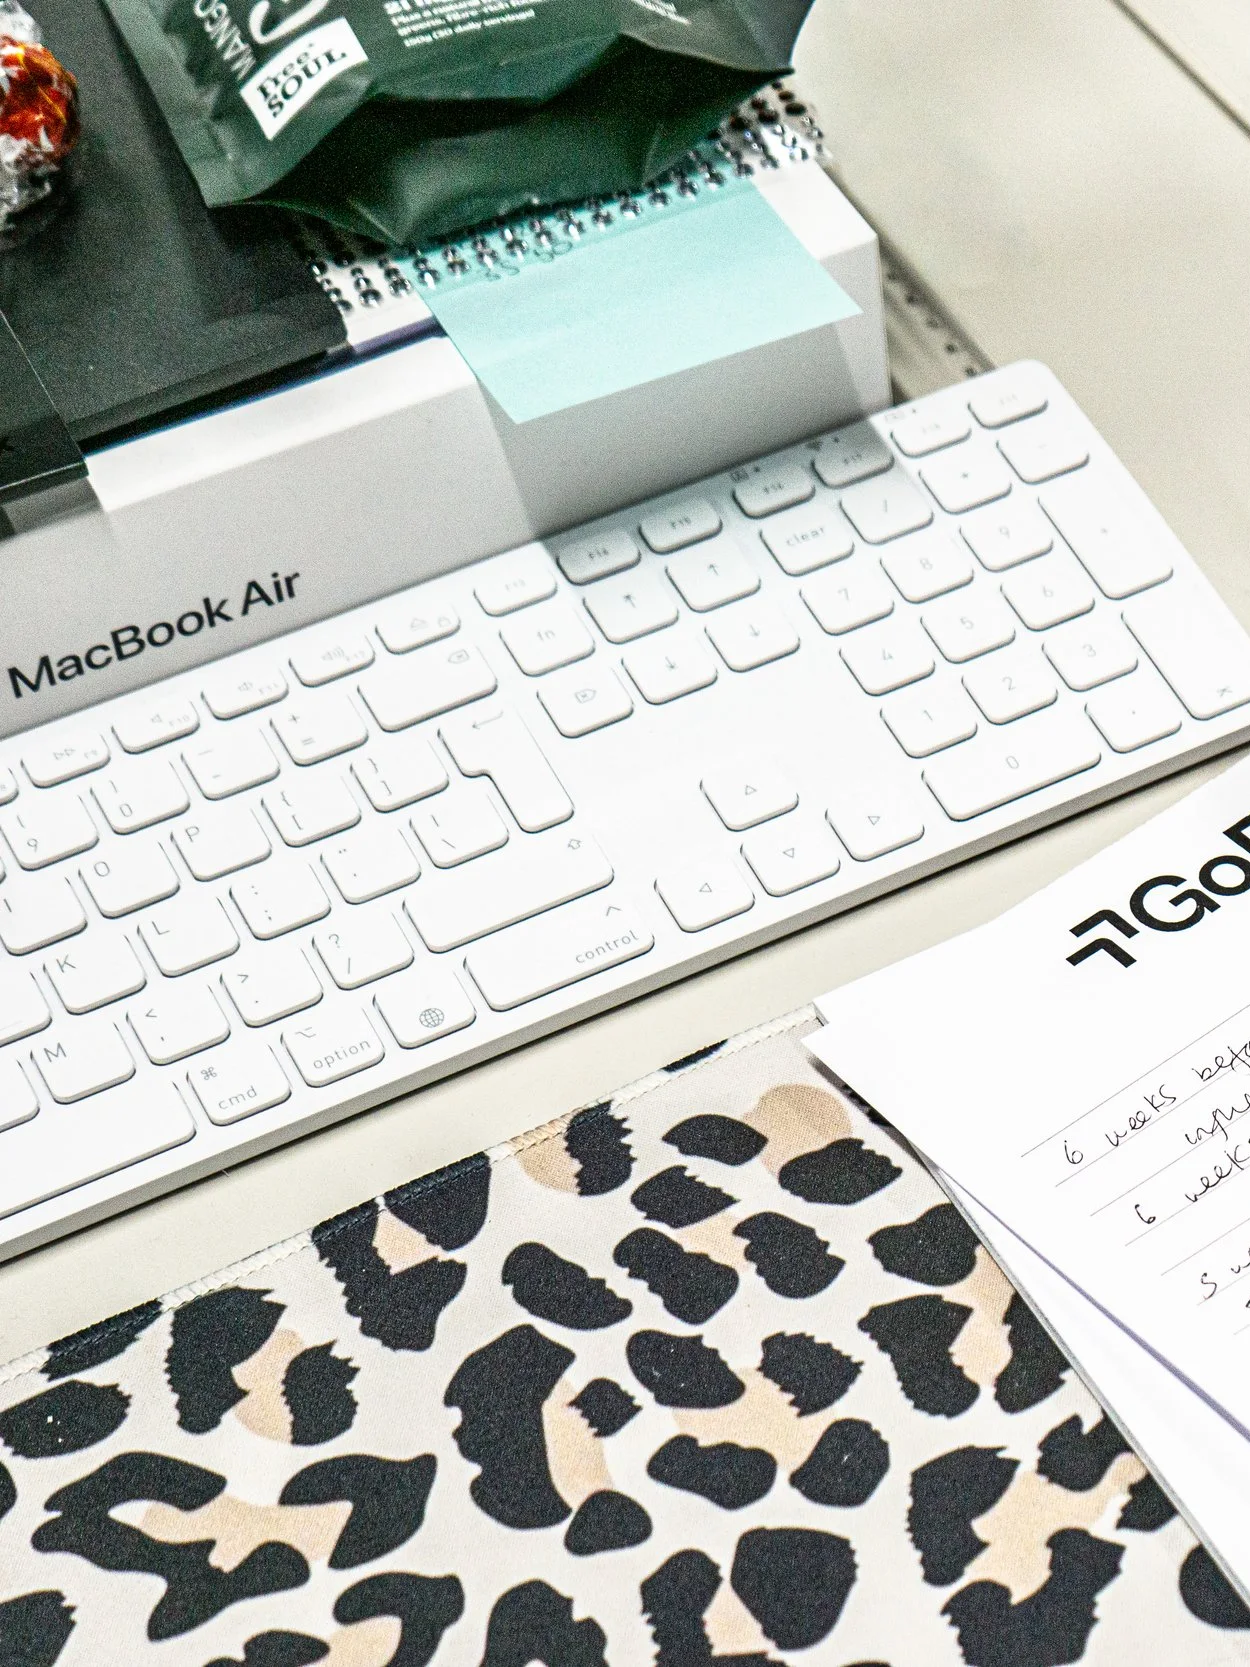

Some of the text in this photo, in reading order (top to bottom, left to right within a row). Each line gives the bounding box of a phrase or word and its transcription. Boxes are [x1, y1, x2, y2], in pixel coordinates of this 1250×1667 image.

[267, 48, 347, 117] SOUL
[786, 526, 826, 547] clear
[1042, 585, 1054, 599] 6
[960, 615, 974, 630] 5
[7, 571, 300, 700] MacBook Air
[536, 628, 556, 642] fn
[881, 647, 893, 661] 4
[1083, 643, 1096, 658] 3
[1002, 676, 1016, 691] 2
[185, 825, 200, 843] P
[152, 921, 170, 936] L
[574, 930, 640, 965] control
[56, 954, 77, 973] K
[43, 1042, 67, 1063] M
[312, 1038, 372, 1070] option
[218, 1085, 258, 1110] cmd
[1064, 1140, 1083, 1164] 6
[1105, 1084, 1176, 1147] weeks
[1135, 1204, 1156, 1224] 6
